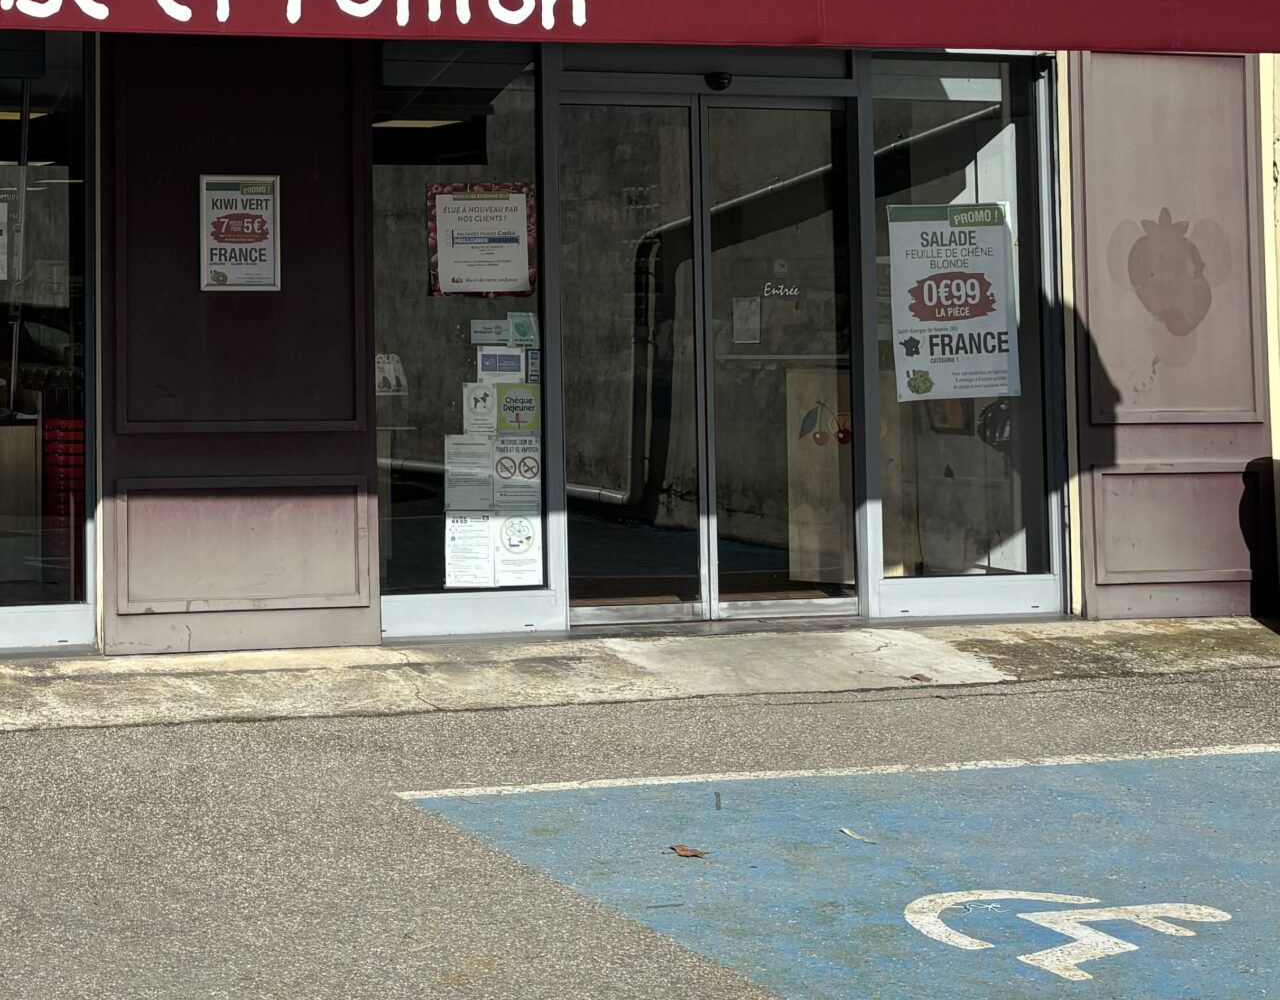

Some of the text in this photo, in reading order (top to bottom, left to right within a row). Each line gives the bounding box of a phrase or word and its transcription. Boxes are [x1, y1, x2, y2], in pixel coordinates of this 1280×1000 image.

[211, 198, 270, 210] KIWI VERT
[954, 208, 998, 224] PROMO !
[220, 219, 228, 233] 7
[921, 230, 977, 248] SALADE
[209, 248, 267, 262] FRANCE
[905, 246, 994, 259] FEUILLE DE CHÊNE
[930, 258, 969, 269] BLONDE
[763, 282, 800, 297] Entrée
[923, 279, 981, 306] 0€99
[935, 306, 970, 317] LA PIÈCE
[929, 332, 1010, 356] FRANCE
